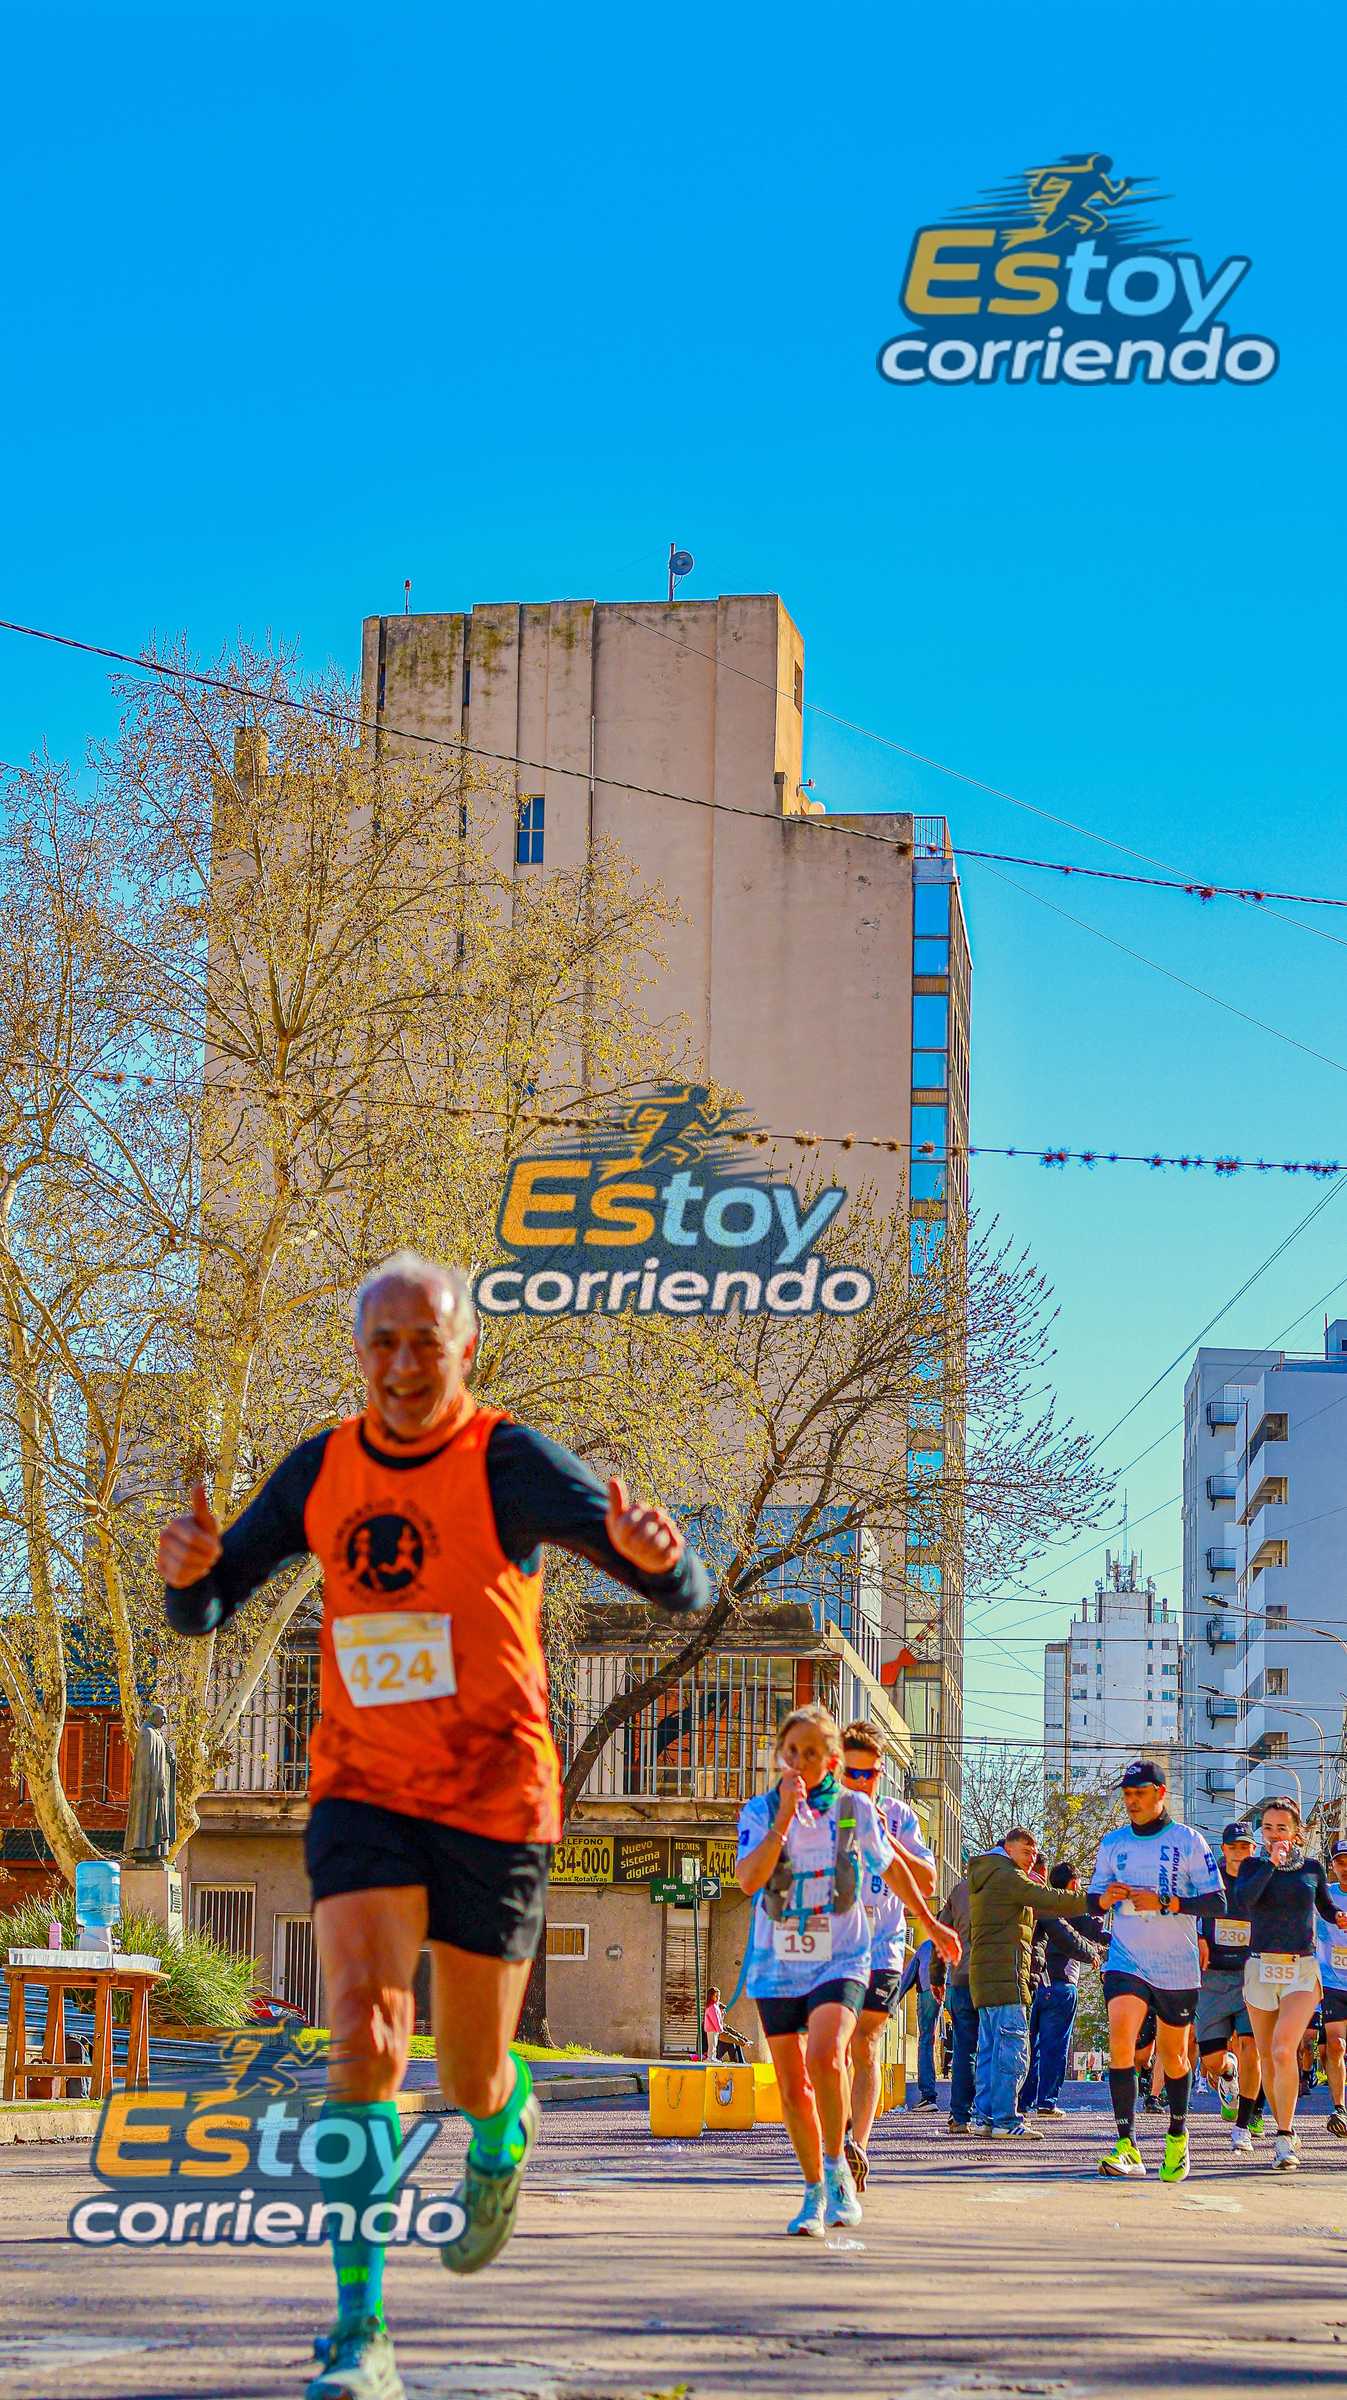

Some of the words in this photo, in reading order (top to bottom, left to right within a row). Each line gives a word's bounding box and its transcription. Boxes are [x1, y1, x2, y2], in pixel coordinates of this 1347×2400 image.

[350, 1648, 438, 1693] 424
[621, 1840, 654, 1857] Nuevo
[620, 1850, 661, 1869] sistema
[784, 1934, 816, 1954] 19
[1219, 1930, 1247, 1943] 230
[1263, 1965, 1296, 1981] 335
